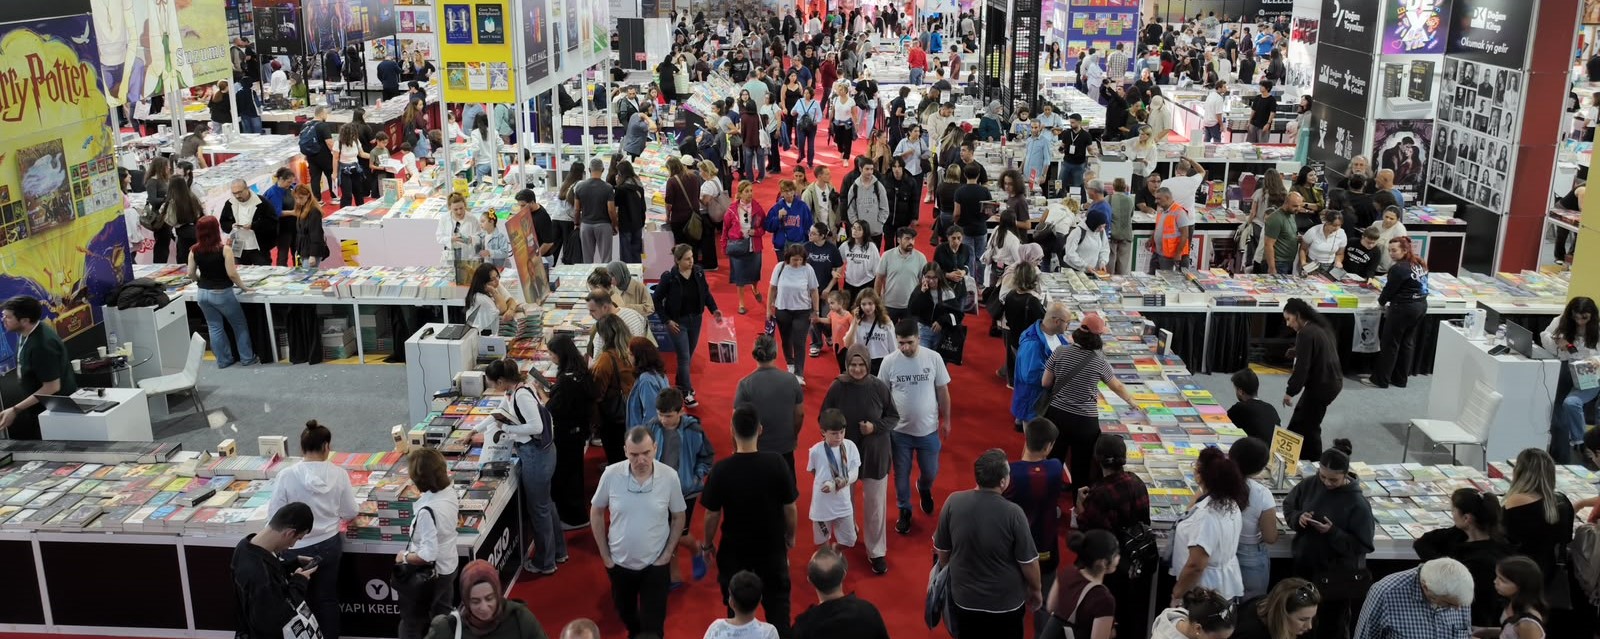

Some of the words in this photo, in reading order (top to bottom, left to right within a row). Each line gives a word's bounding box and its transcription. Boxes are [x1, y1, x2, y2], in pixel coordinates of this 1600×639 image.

[1487, 10, 1507, 22] Doğan
[1486, 22, 1502, 33] Kitap
[1461, 37, 1486, 50] Okumak
[1485, 41, 1494, 53] iyi
[1493, 43, 1510, 54] gelir
[0, 67, 28, 122] rry
[25, 53, 90, 128] Potter
[896, 375, 912, 383] NEW
[339, 603, 365, 613] YAPI
[368, 603, 401, 614] KRED
